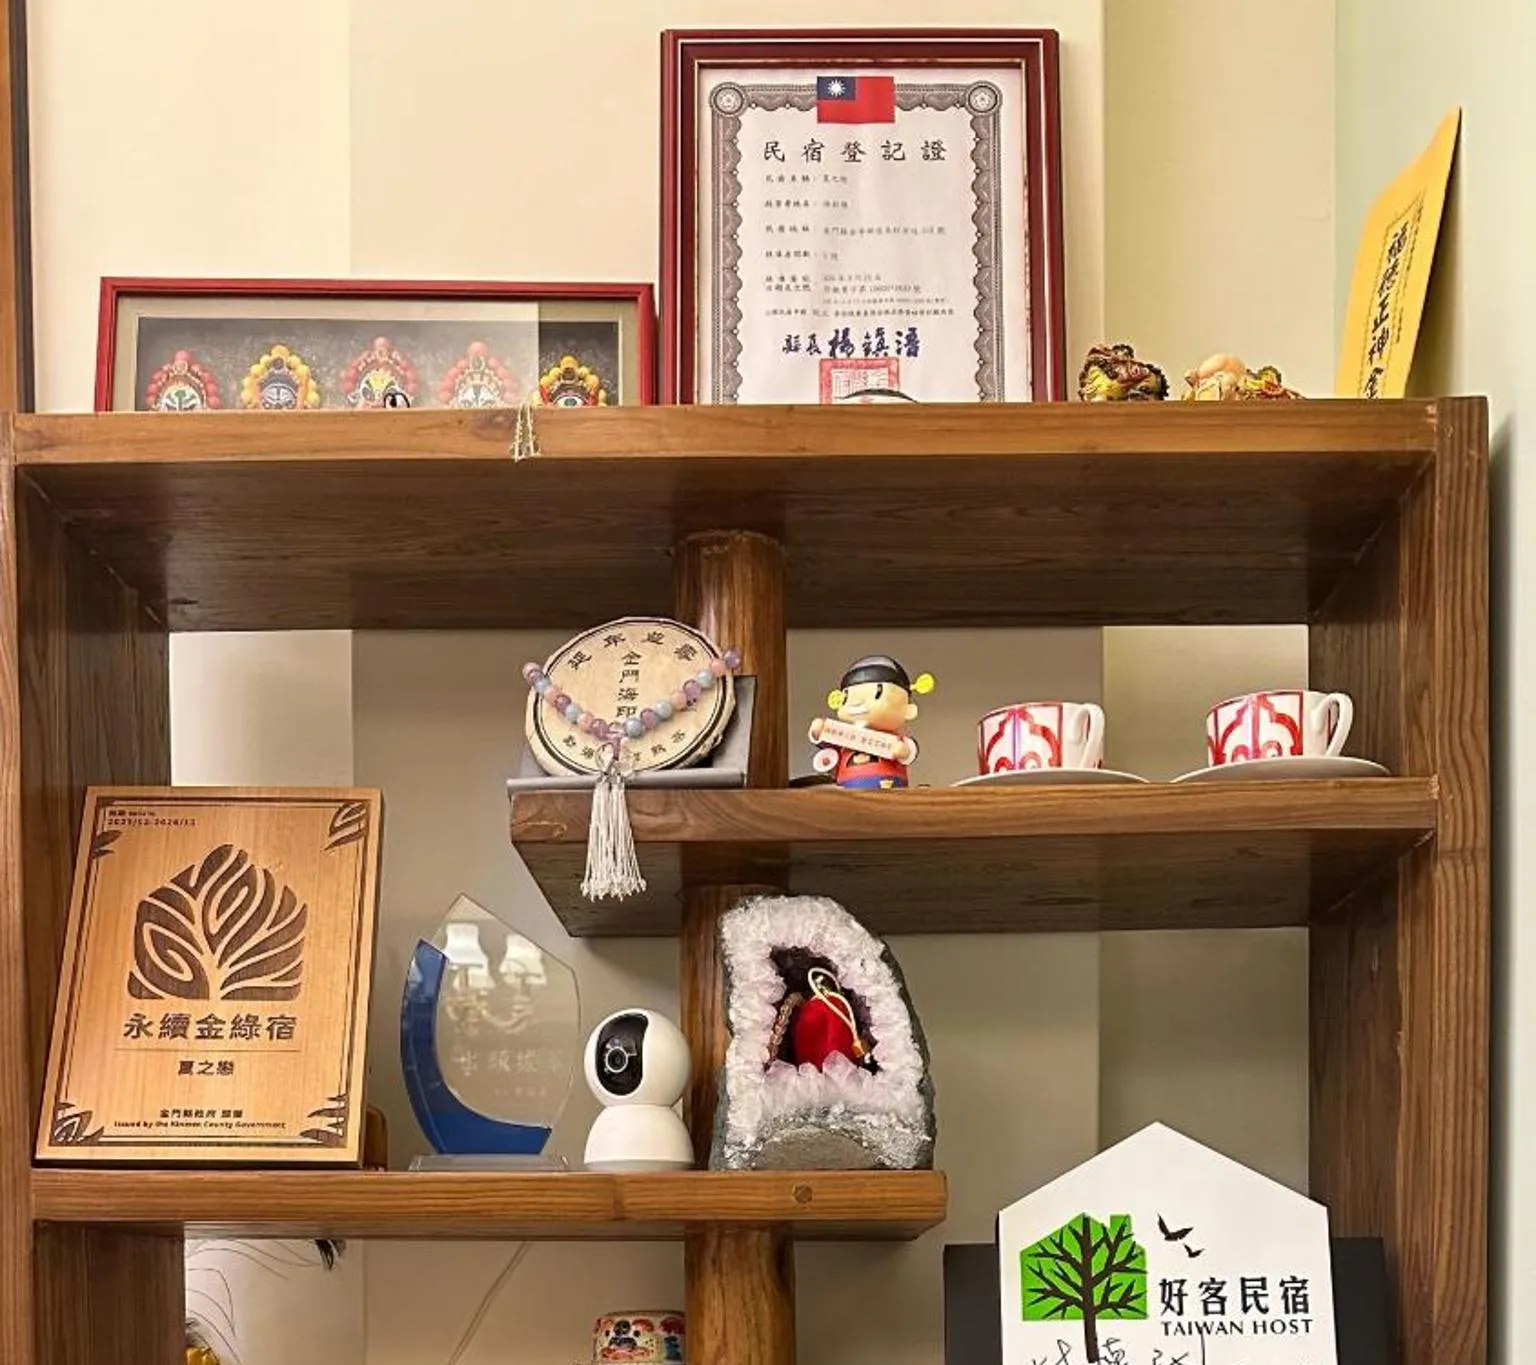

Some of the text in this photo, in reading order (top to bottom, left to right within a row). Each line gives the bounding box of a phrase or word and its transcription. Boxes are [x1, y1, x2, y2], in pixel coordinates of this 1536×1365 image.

[764, 138, 947, 163] 民宿登記證
[123, 1012, 297, 1041] 永續金綠宿
[178, 1060, 235, 1076] 夏之戀
[1159, 1275, 1310, 1317] 好客民宿
[1161, 1319, 1314, 1337] TAIWAN HOST
